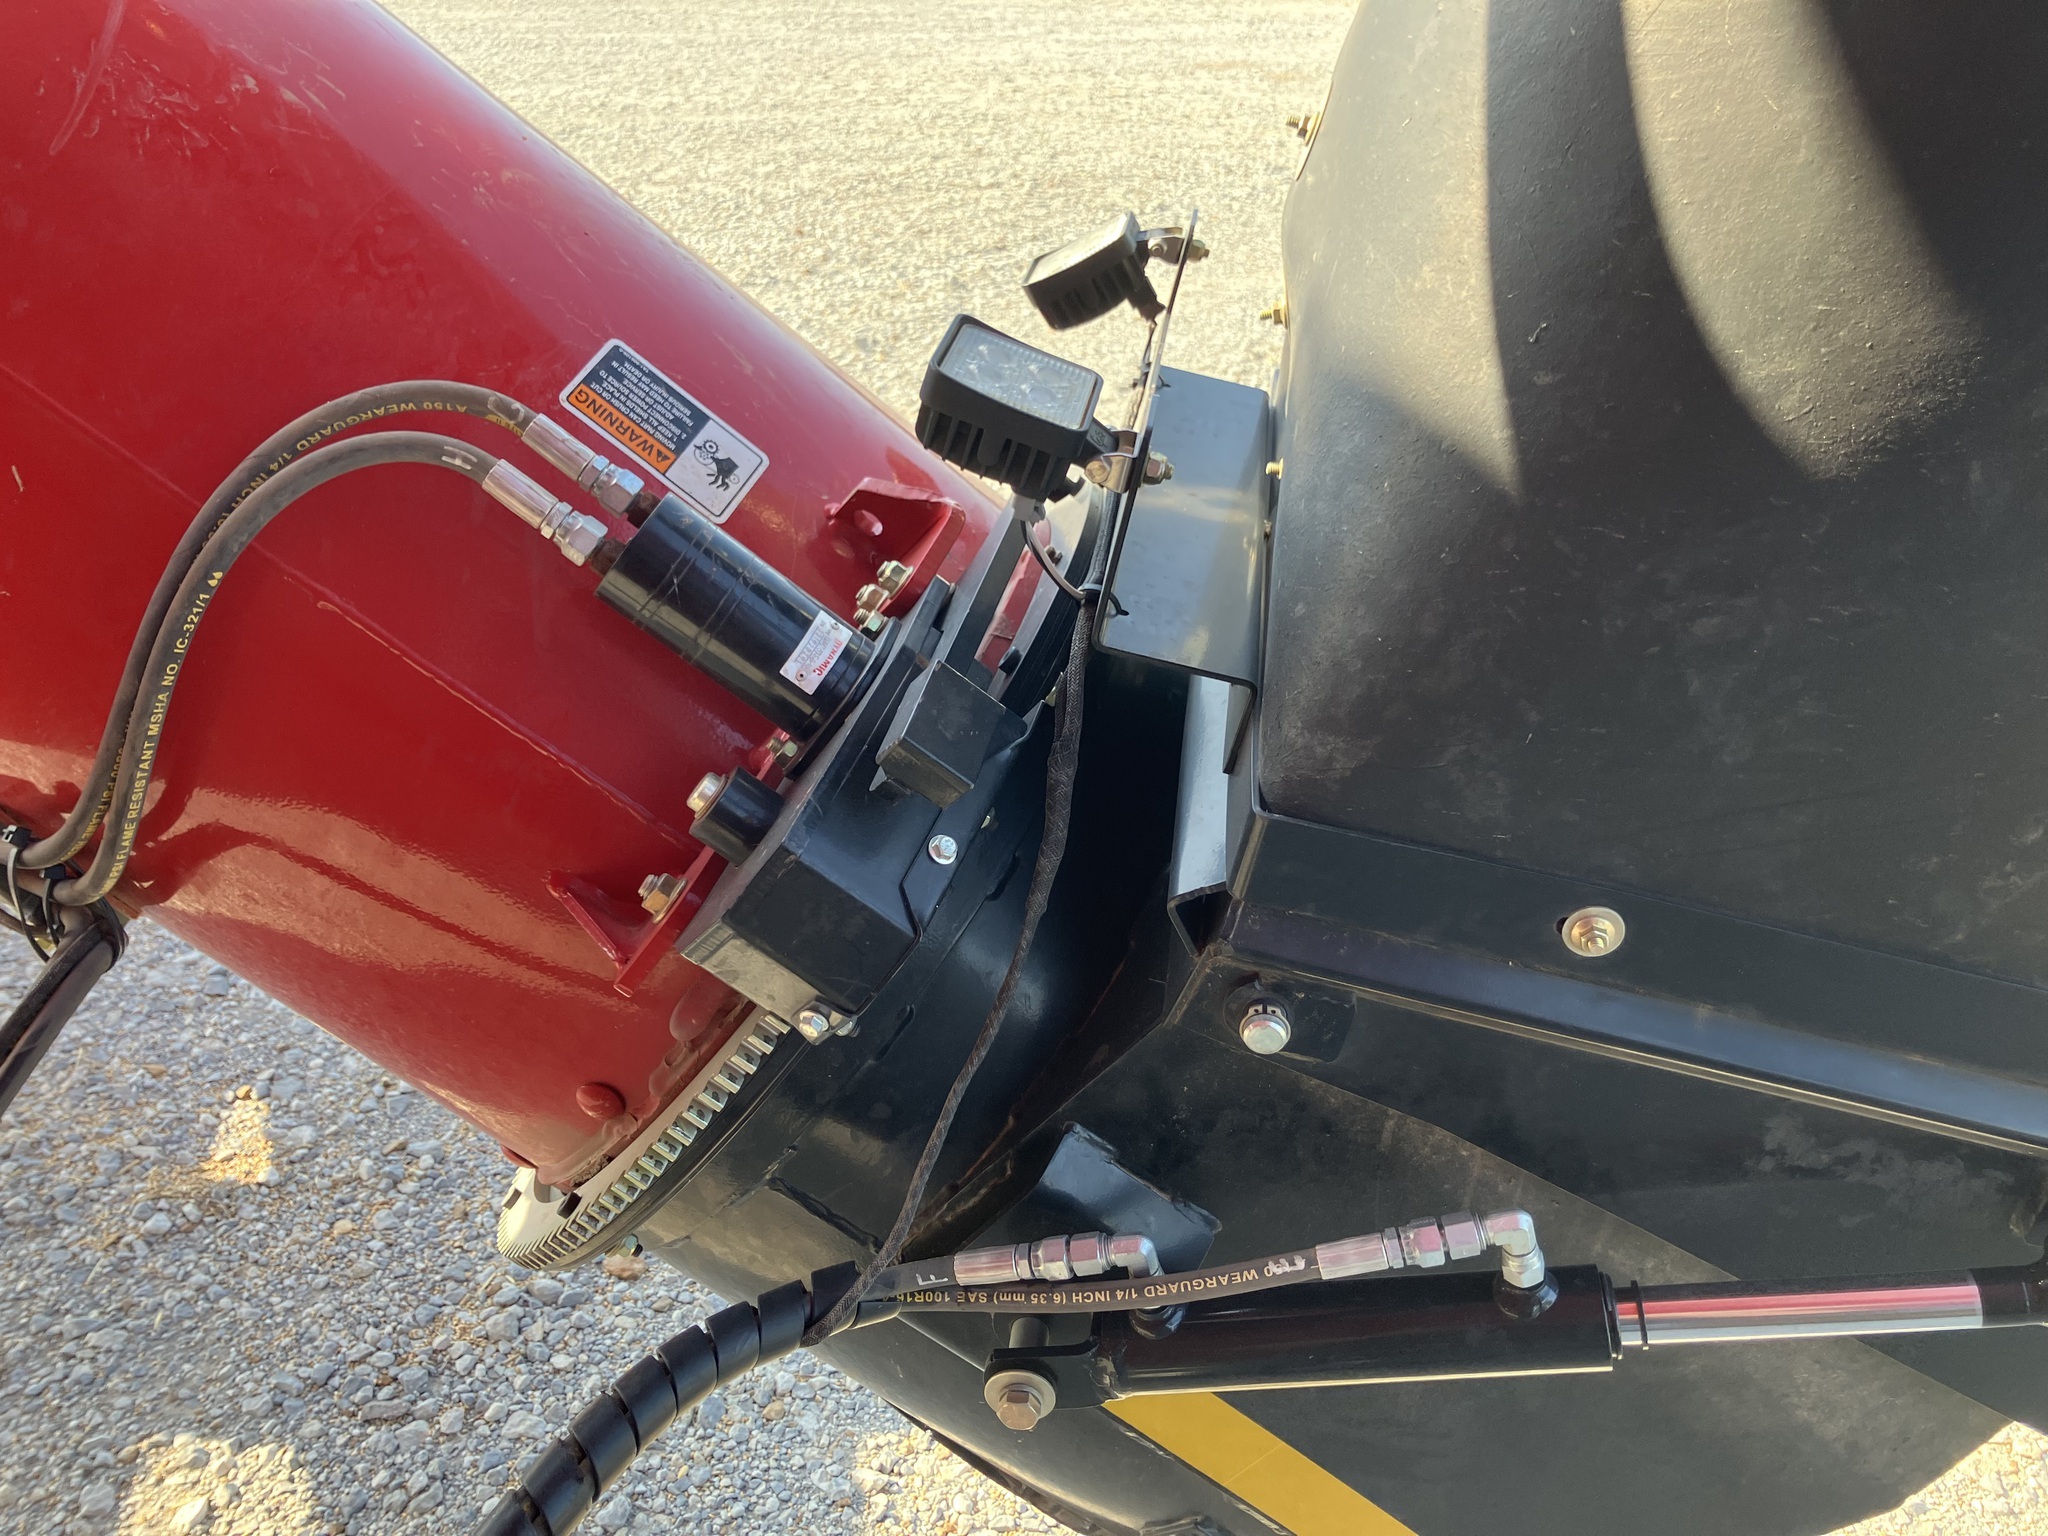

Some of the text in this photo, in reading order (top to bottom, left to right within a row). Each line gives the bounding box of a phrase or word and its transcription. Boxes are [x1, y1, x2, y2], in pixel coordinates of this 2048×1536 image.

[600, 390, 611, 400] OR
[610, 360, 694, 426] FAILURE TO HEED MAY RESULT IN
[622, 360, 692, 416] SERIOUS INJURY OR DEATH.
[423, 402, 467, 413] A150
[598, 368, 687, 439] 2. DISCONNECT POWER SOURCE TO
[609, 397, 630, 415] CRUSH
[620, 377, 675, 421] ADJUST OR SERVICE.
[599, 379, 678, 442] 1. KEEP ALL SHIELDS IN PLACE.
[627, 411, 642, 424] CAN
[296, 402, 417, 452] WEARGUARD
[573, 388, 657, 457] WARNING
[639, 420, 655, 434] PART
[653, 430, 676, 450] MOVING
[269, 452, 293, 472] 1/4
[813, 639, 843, 676] DYNAMIC
[116, 819, 137, 860] FLAME
[127, 740, 155, 820] RESISTANT
[147, 692, 170, 736] MSHA
[161, 660, 181, 686] NO.
[174, 593, 210, 653] IC-321/1
[915, 1273, 949, 1286] F
[1145, 1268, 1259, 1298] WEARGUARD
[957, 1291, 987, 1304] SAE
[993, 1291, 1026, 1305] mm)
[1031, 1291, 1067, 1305] (6.35
[1072, 1291, 1111, 1304] INCH
[1116, 1286, 1138, 1302] 1/4
